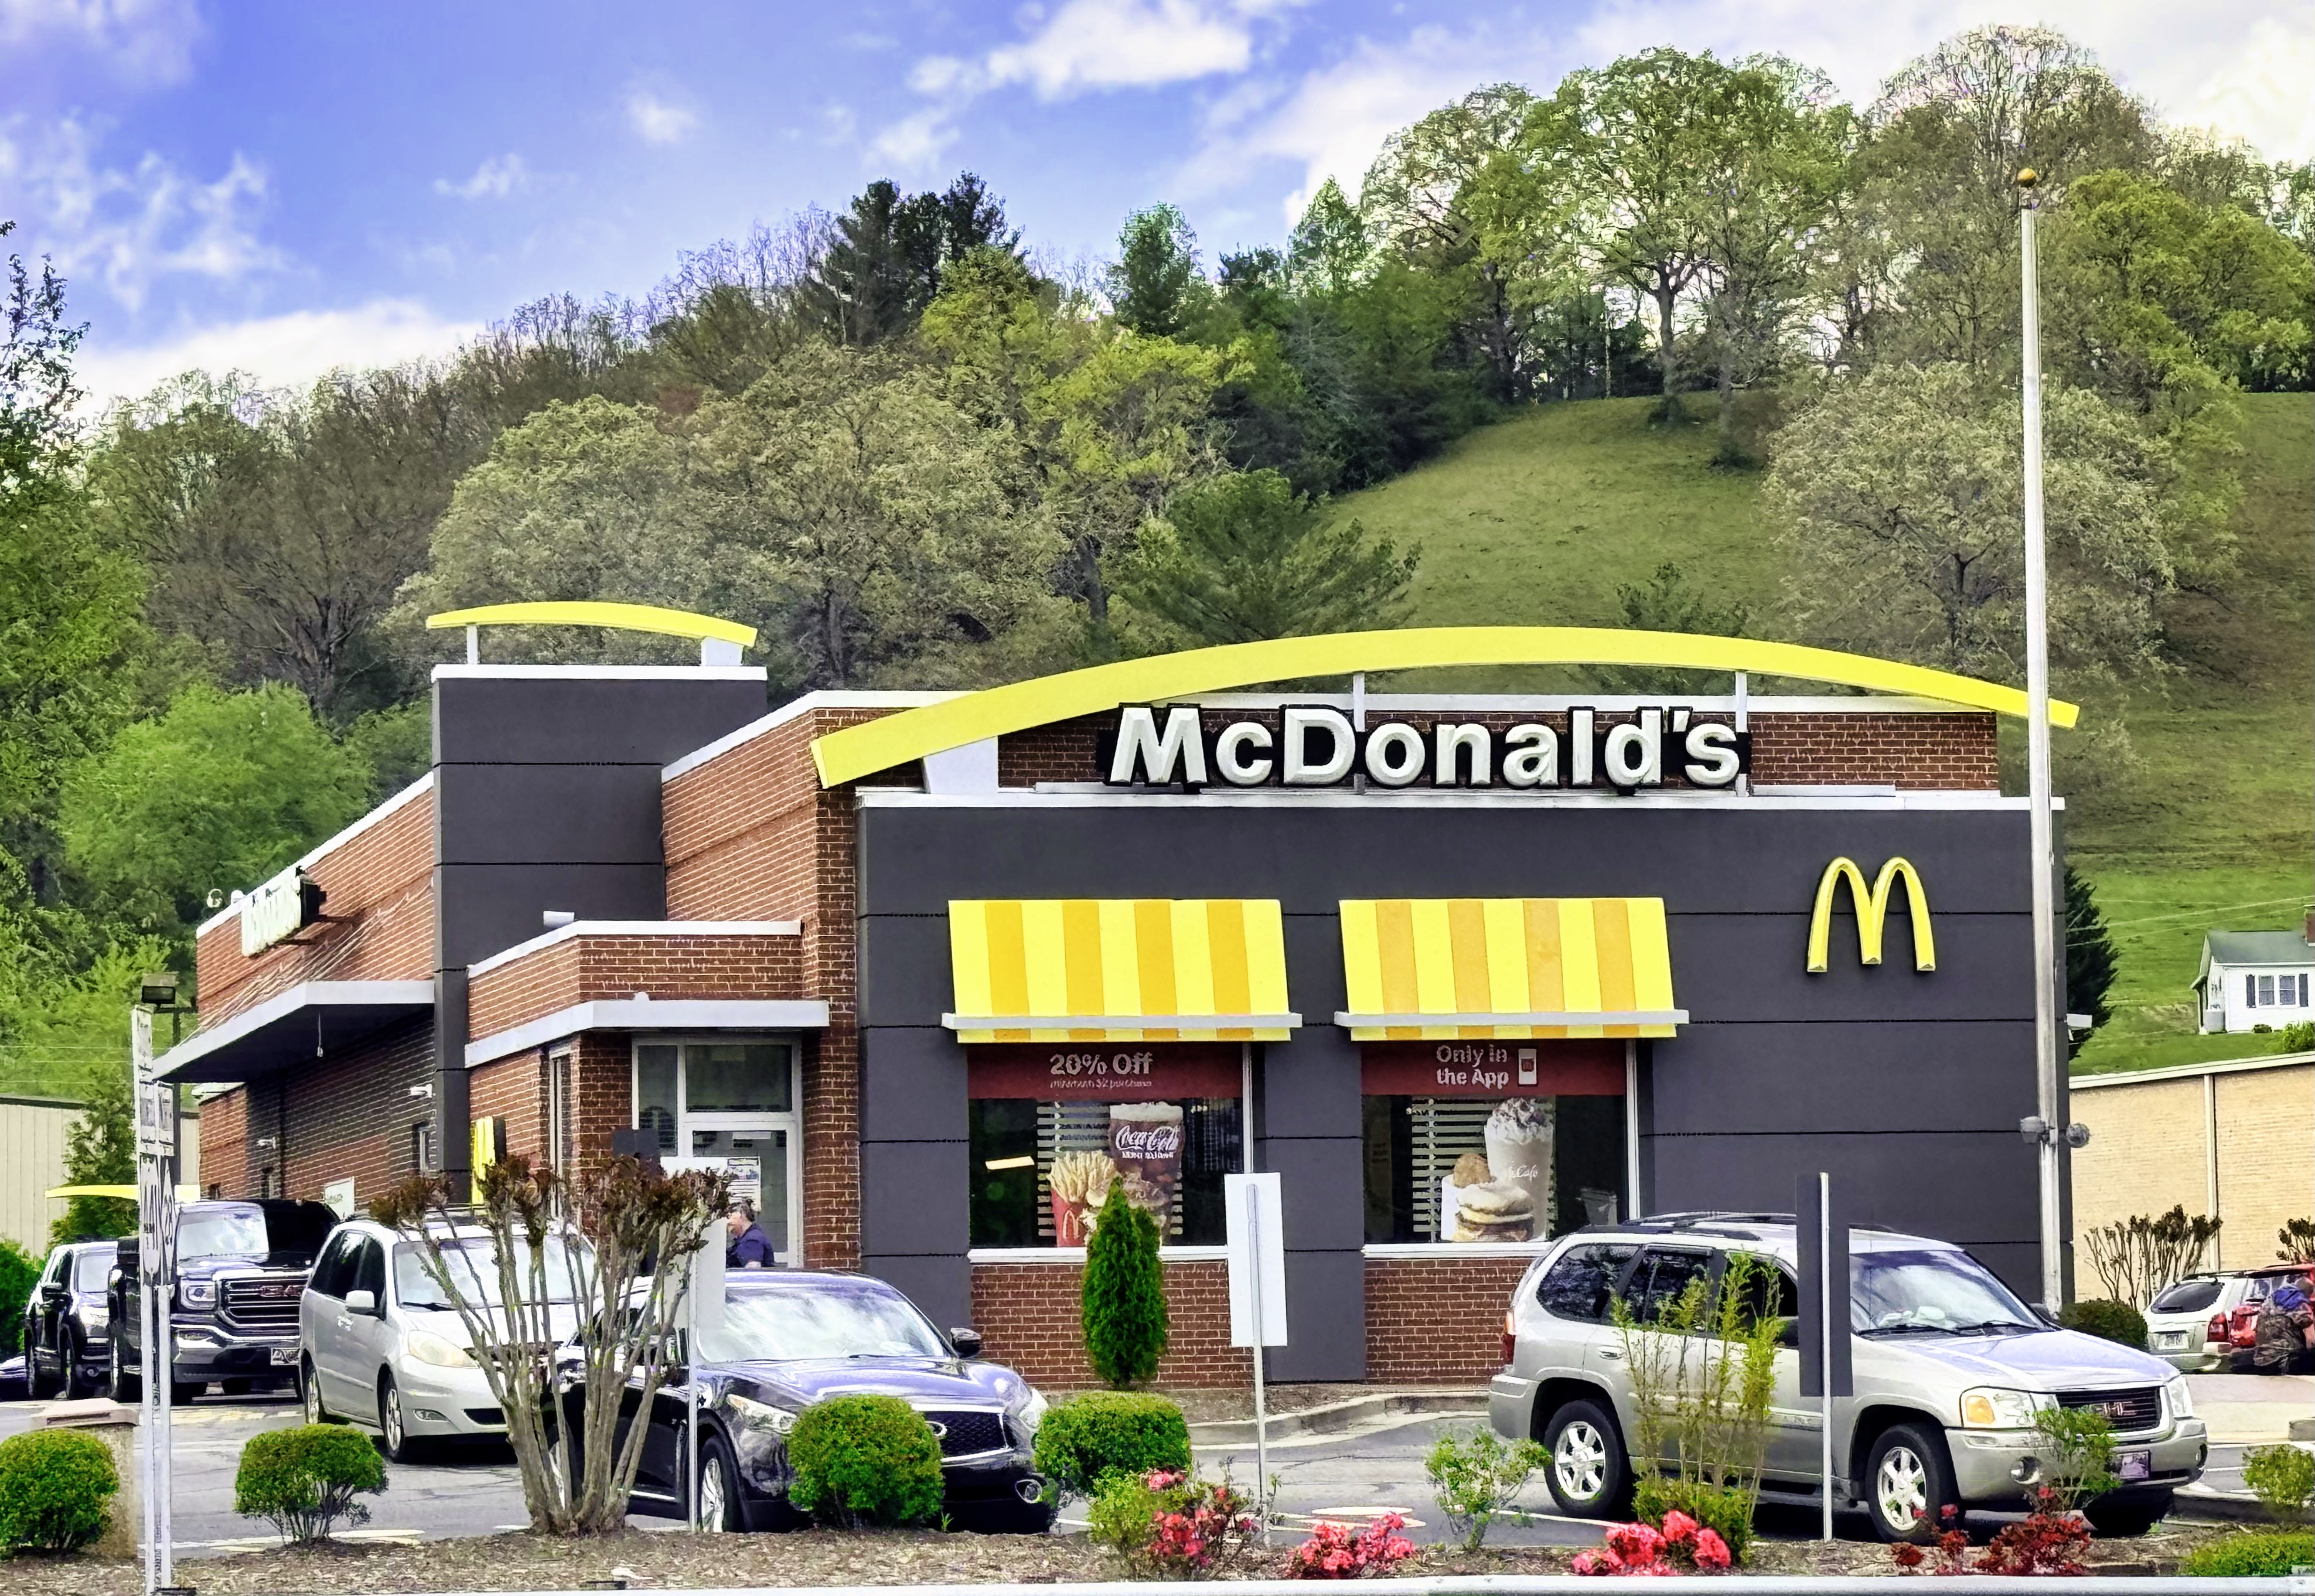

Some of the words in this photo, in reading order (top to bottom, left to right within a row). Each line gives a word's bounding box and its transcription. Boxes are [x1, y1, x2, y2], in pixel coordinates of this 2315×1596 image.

[1107, 705, 1740, 787] McDonald's
[1806, 856, 1936, 973] M
[1049, 1053, 1108, 1075] 20%
[1113, 1052, 1154, 1075] Off
[1436, 1045, 1484, 1068] Only
[1489, 1044, 1508, 1063] in
[1437, 1068, 1467, 1086] the
[1471, 1069, 1509, 1090] App
